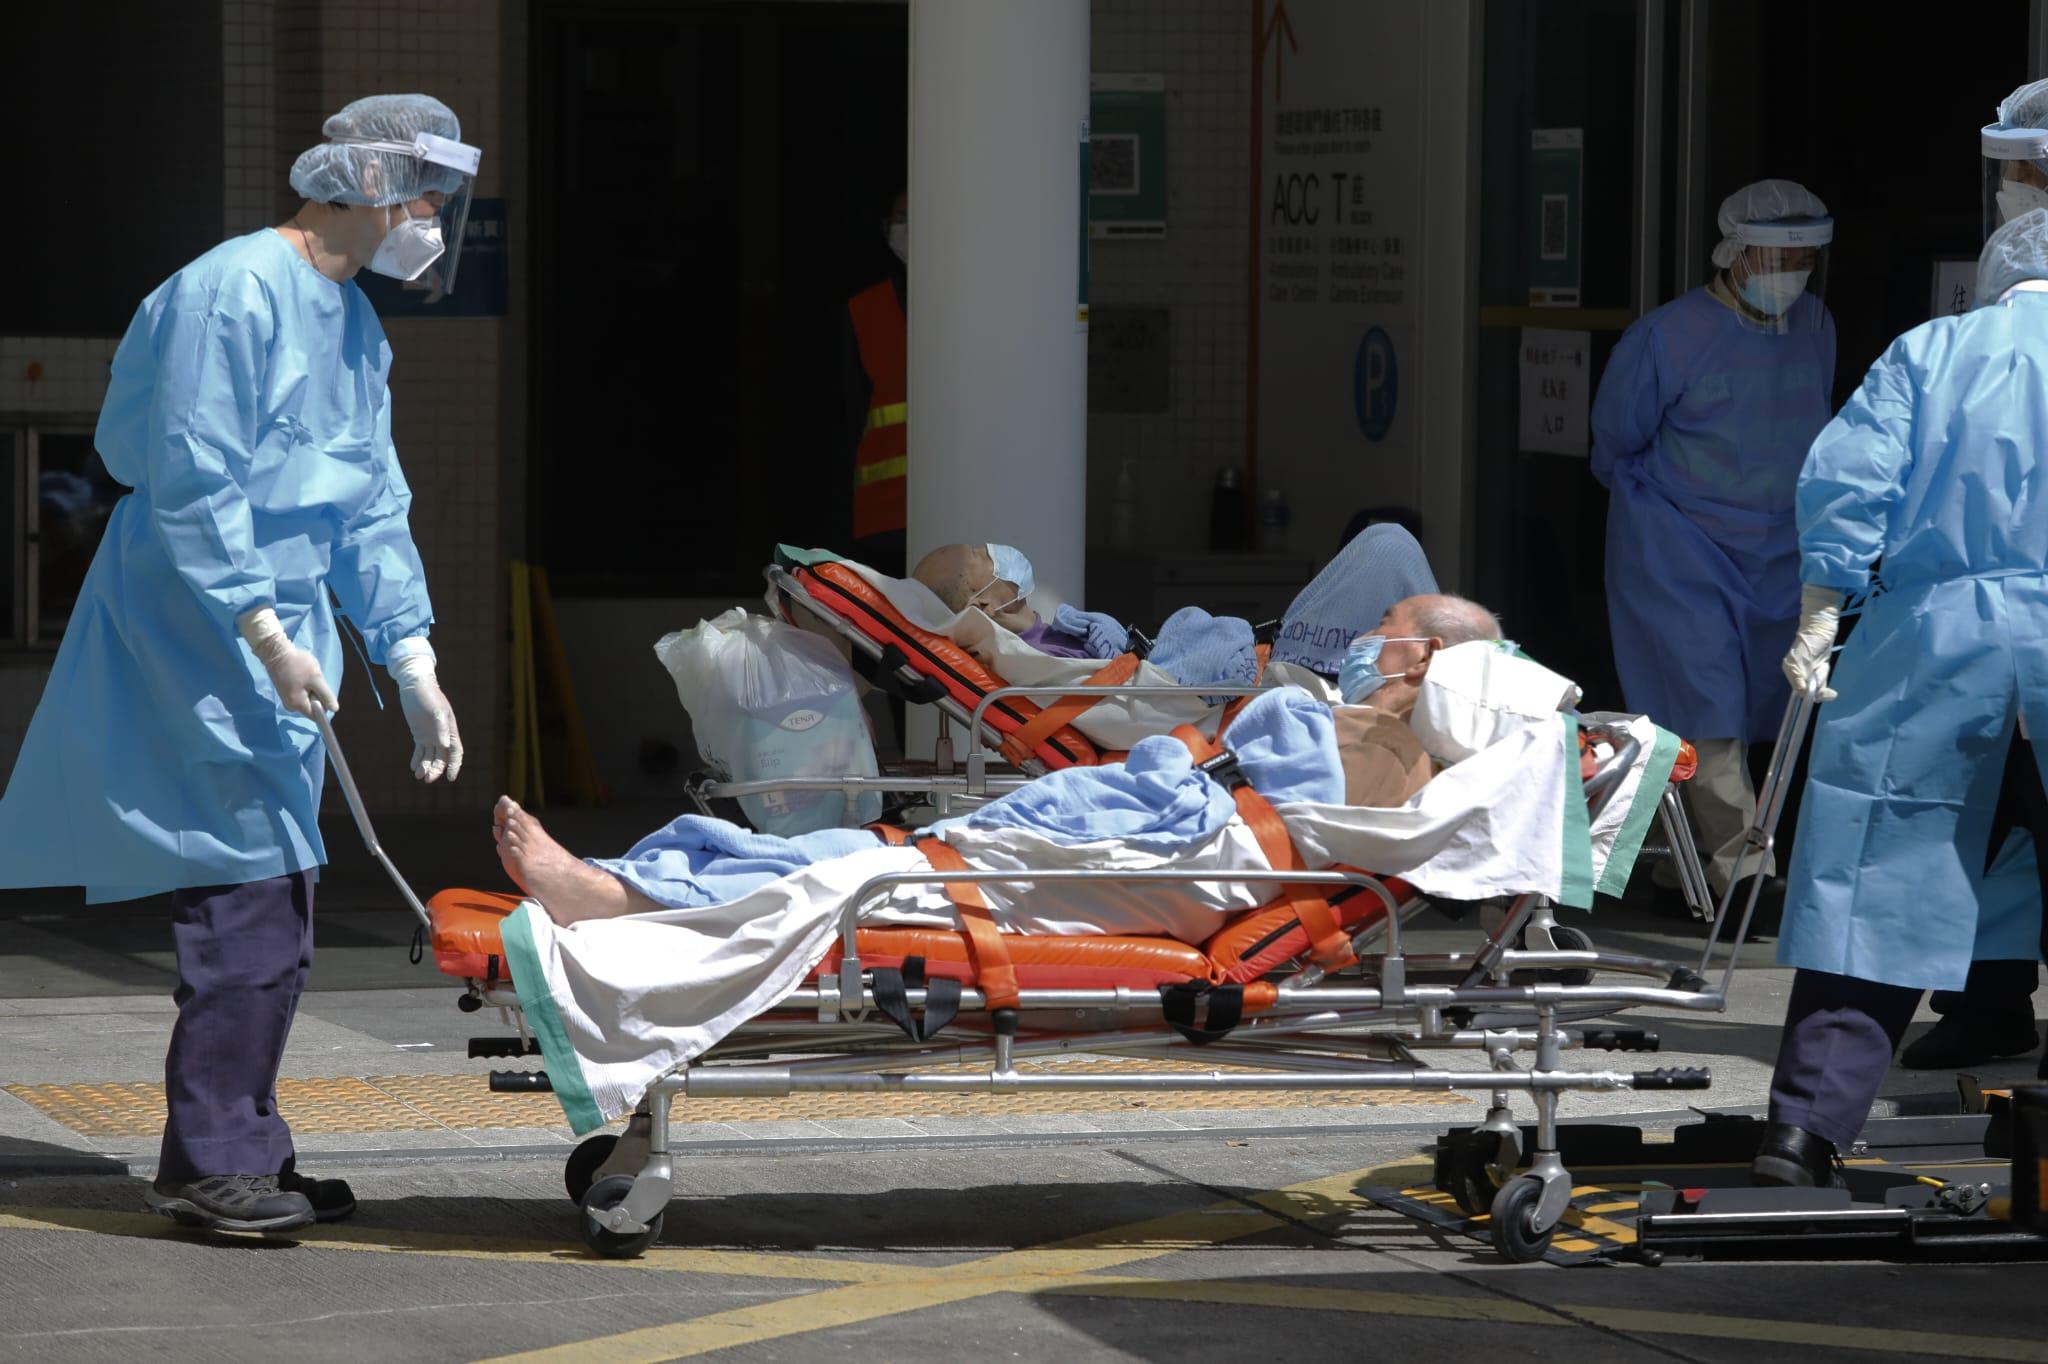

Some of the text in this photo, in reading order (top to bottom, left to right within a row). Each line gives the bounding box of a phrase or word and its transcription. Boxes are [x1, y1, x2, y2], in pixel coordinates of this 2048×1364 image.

[1271, 172, 1348, 225] ACC T
[1366, 343, 1386, 417] P
[788, 713, 816, 727] TENA
